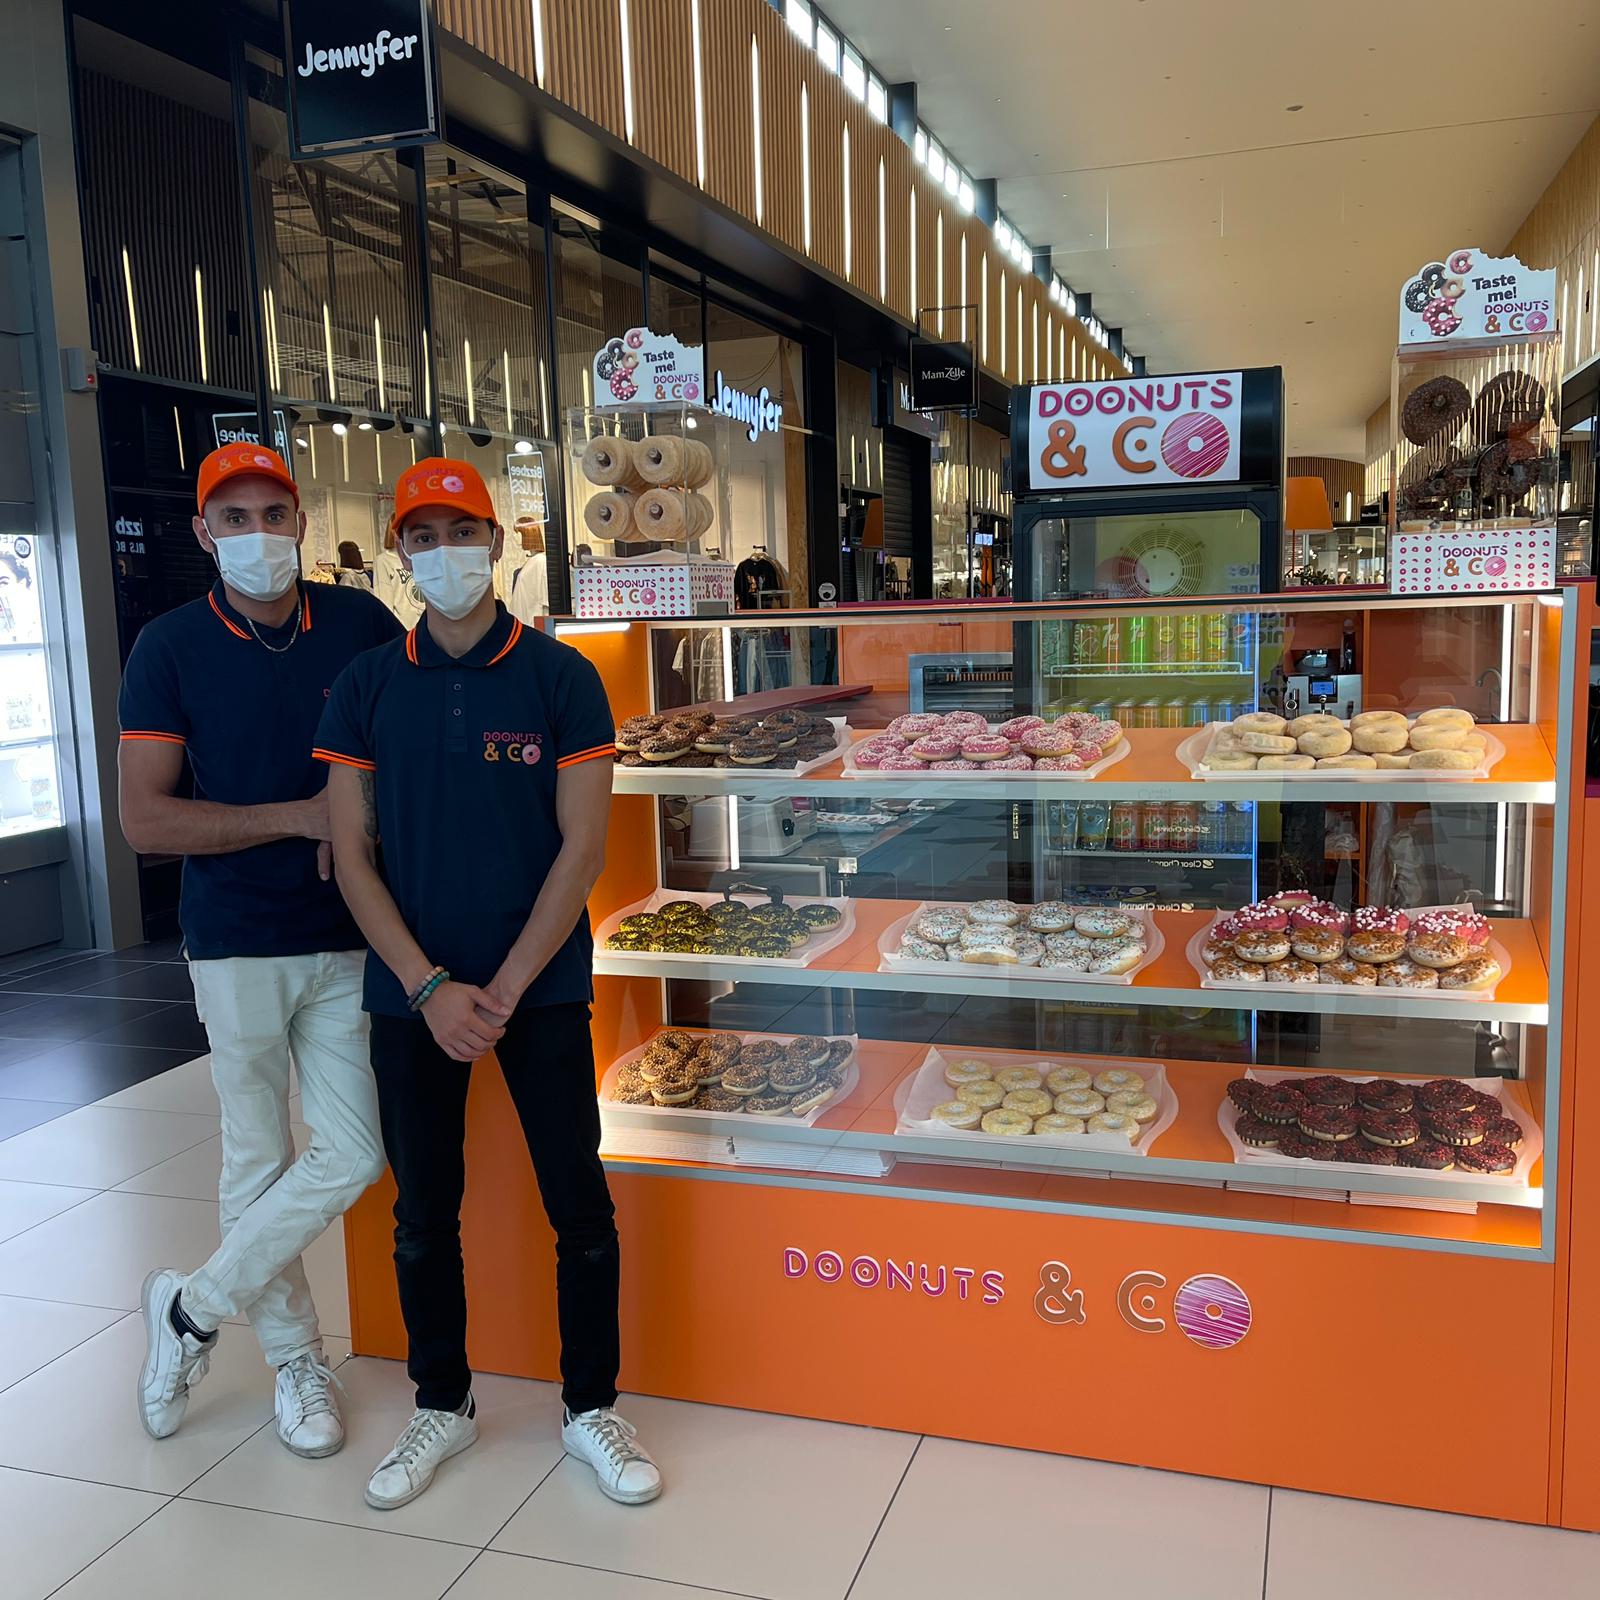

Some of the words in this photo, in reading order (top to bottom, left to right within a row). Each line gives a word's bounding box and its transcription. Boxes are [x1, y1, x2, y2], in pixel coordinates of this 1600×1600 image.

[298, 30, 418, 78] Jennyfer
[1472, 274, 1516, 290] Taste
[1488, 287, 1517, 302] me!
[1484, 300, 1549, 314] DOONUTS
[1484, 315, 1500, 333] &
[1509, 311, 1548, 332] CO
[643, 350, 675, 364] Taste
[655, 361, 676, 373] me!
[922, 368, 966, 380] MamZelle
[653, 374, 700, 384] DOONUTS
[655, 384, 666, 400] &
[672, 382, 699, 400] CO
[1038, 378, 1232, 417] DOONUTS
[712, 370, 783, 442] Jennyfer
[1040, 419, 1088, 478] &
[1112, 411, 1230, 478] CO
[426, 476, 464, 493] CO
[1442, 546, 1508, 558] DOONUTS
[1444, 558, 1460, 577] &
[1468, 556, 1507, 576] CO
[610, 579, 656, 588] DOONUTS
[612, 589, 624, 604] &
[628, 588, 656, 606] CO
[483, 732, 542, 744] DOONUTS
[484, 742, 500, 762] &
[507, 744, 542, 765] CO
[783, 1246, 1005, 1305] DOONUTS
[1034, 1260, 1087, 1325] &
[1116, 1270, 1252, 1350] CO
